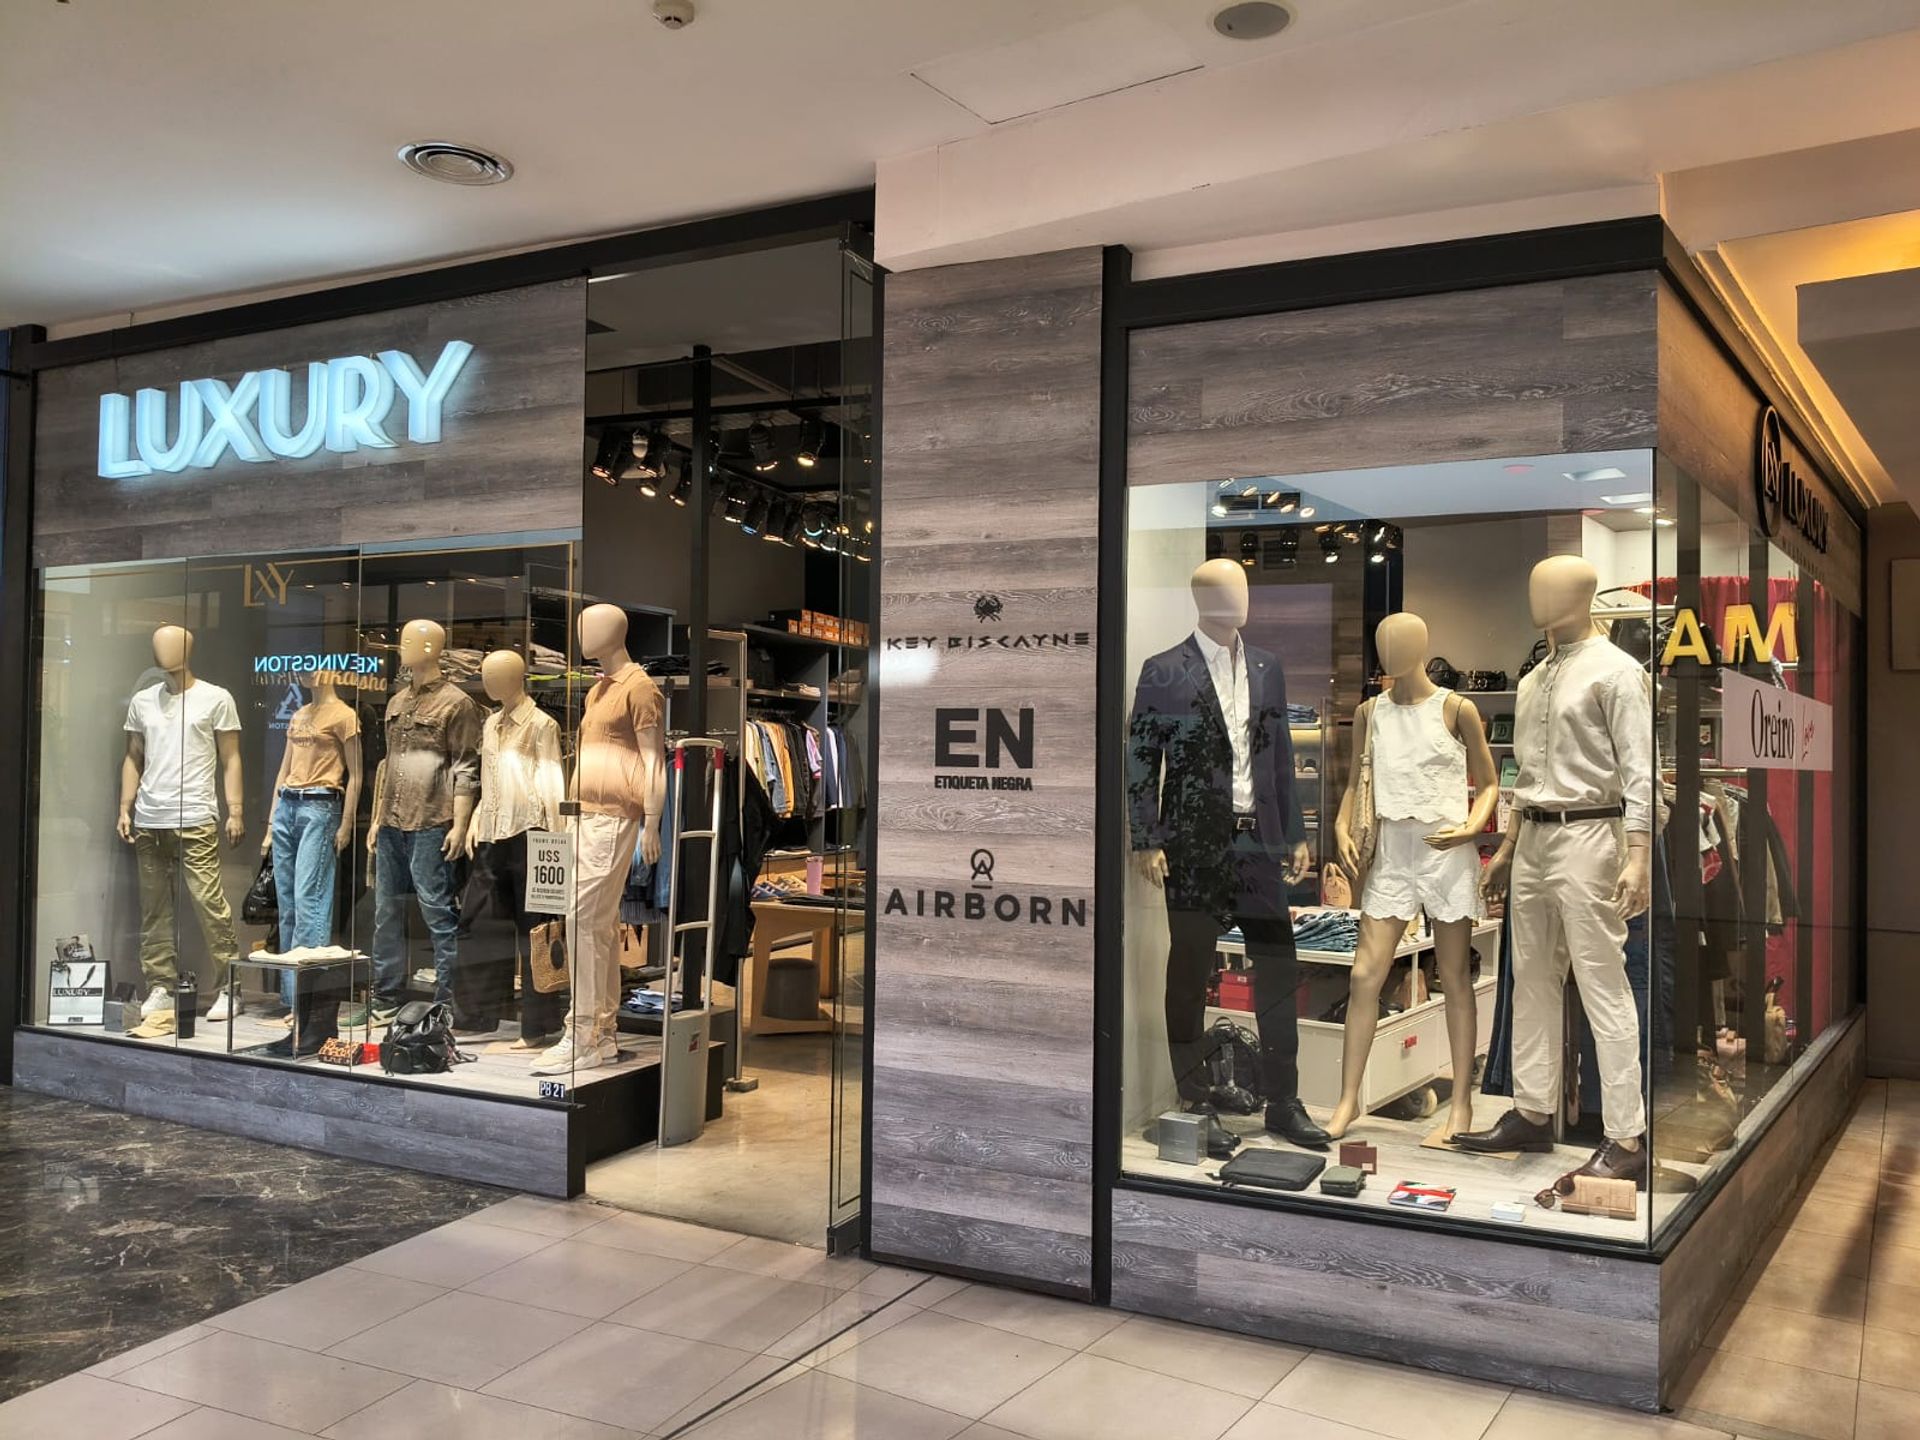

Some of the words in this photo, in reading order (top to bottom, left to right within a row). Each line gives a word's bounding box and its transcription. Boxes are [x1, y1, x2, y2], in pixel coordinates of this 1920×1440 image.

[97, 340, 475, 480] LUXURY
[887, 636, 937, 650] KEY
[948, 632, 1090, 649] BISCAYNE
[935, 708, 1034, 769] EN
[1750, 689, 1795, 760] Oreiro
[934, 775, 990, 790] ETIQUETA
[992, 776, 1033, 791] NEGRA
[534, 865, 565, 885] 1600
[884, 888, 1086, 927] AIRBORN
